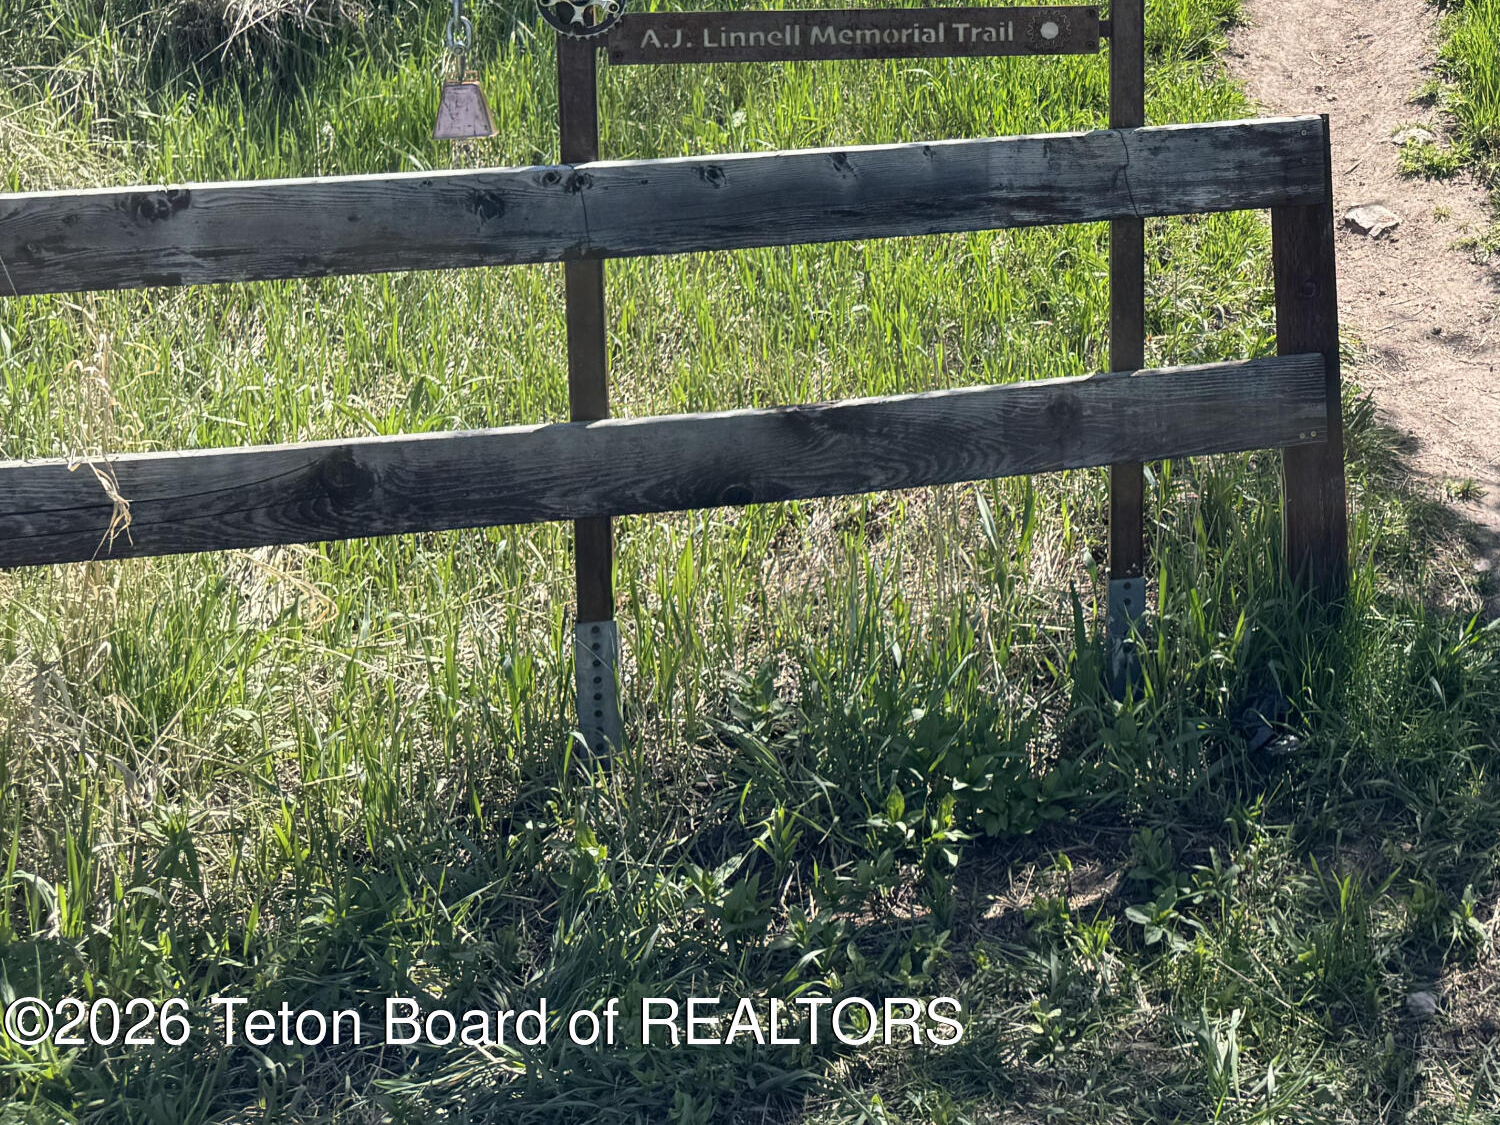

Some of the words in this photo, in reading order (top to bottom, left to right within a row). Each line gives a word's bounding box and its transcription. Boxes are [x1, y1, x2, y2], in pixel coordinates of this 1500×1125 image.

[640, 29, 692, 49] A.J.
[703, 25, 801, 48] Linnell
[809, 22, 945, 46] Memorial
[952, 21, 1014, 43] Trail
